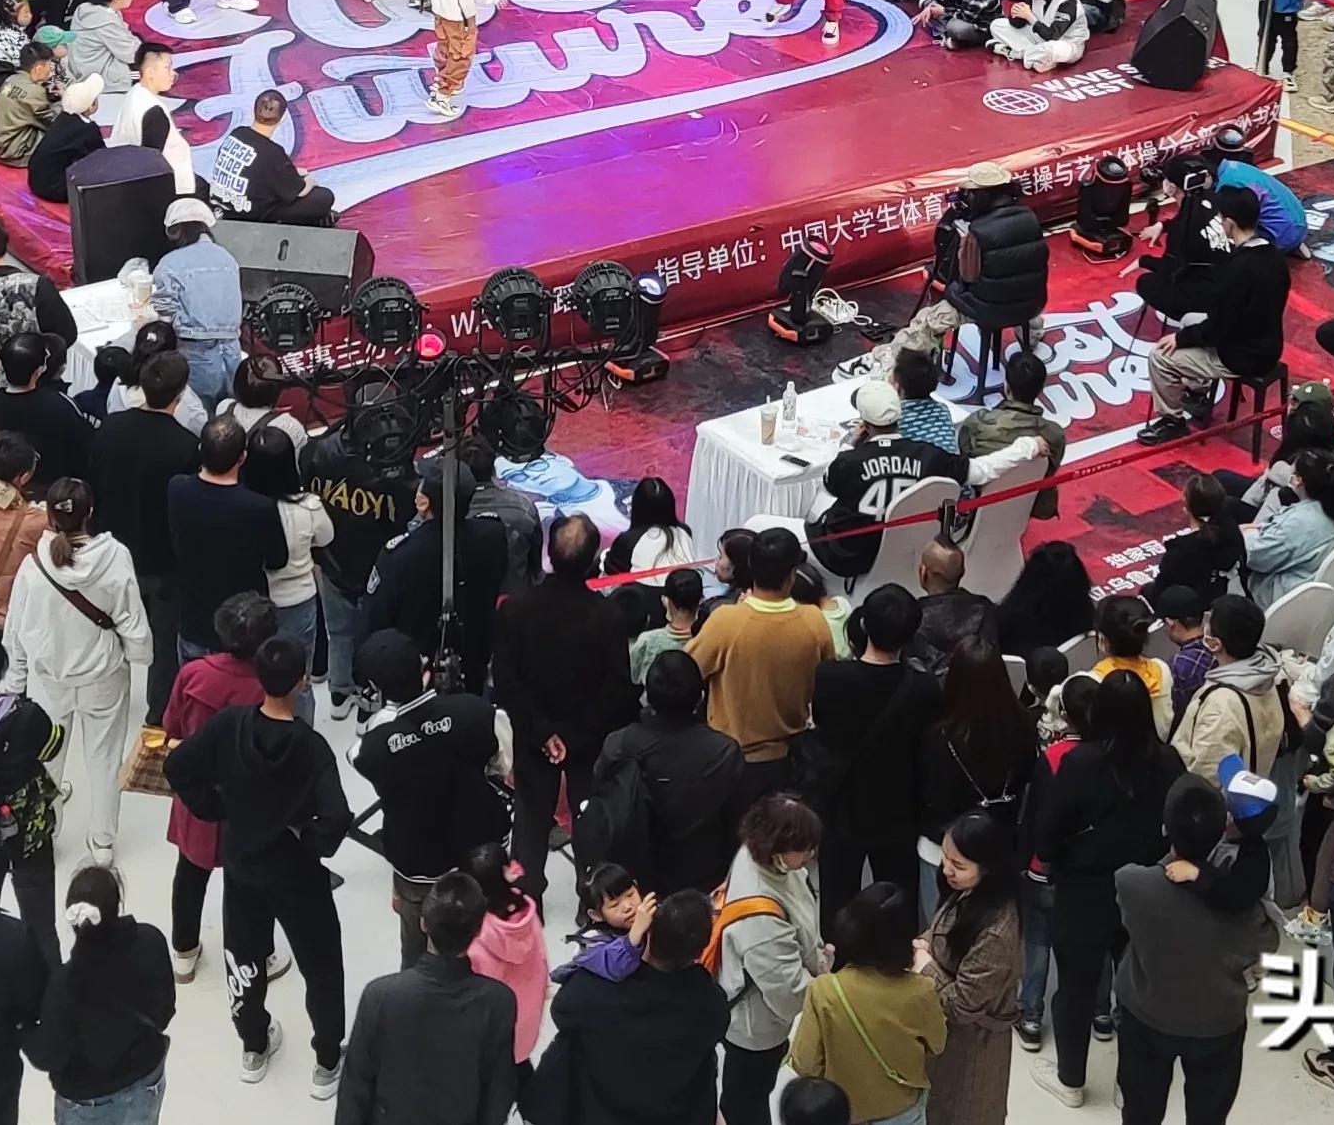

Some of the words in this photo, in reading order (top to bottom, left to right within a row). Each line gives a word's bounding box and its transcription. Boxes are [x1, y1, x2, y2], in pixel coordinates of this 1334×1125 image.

[1030, 67, 1123, 93] WAVE
[1051, 77, 1135, 103] WEST
[860, 456, 922, 481] JORDAN
